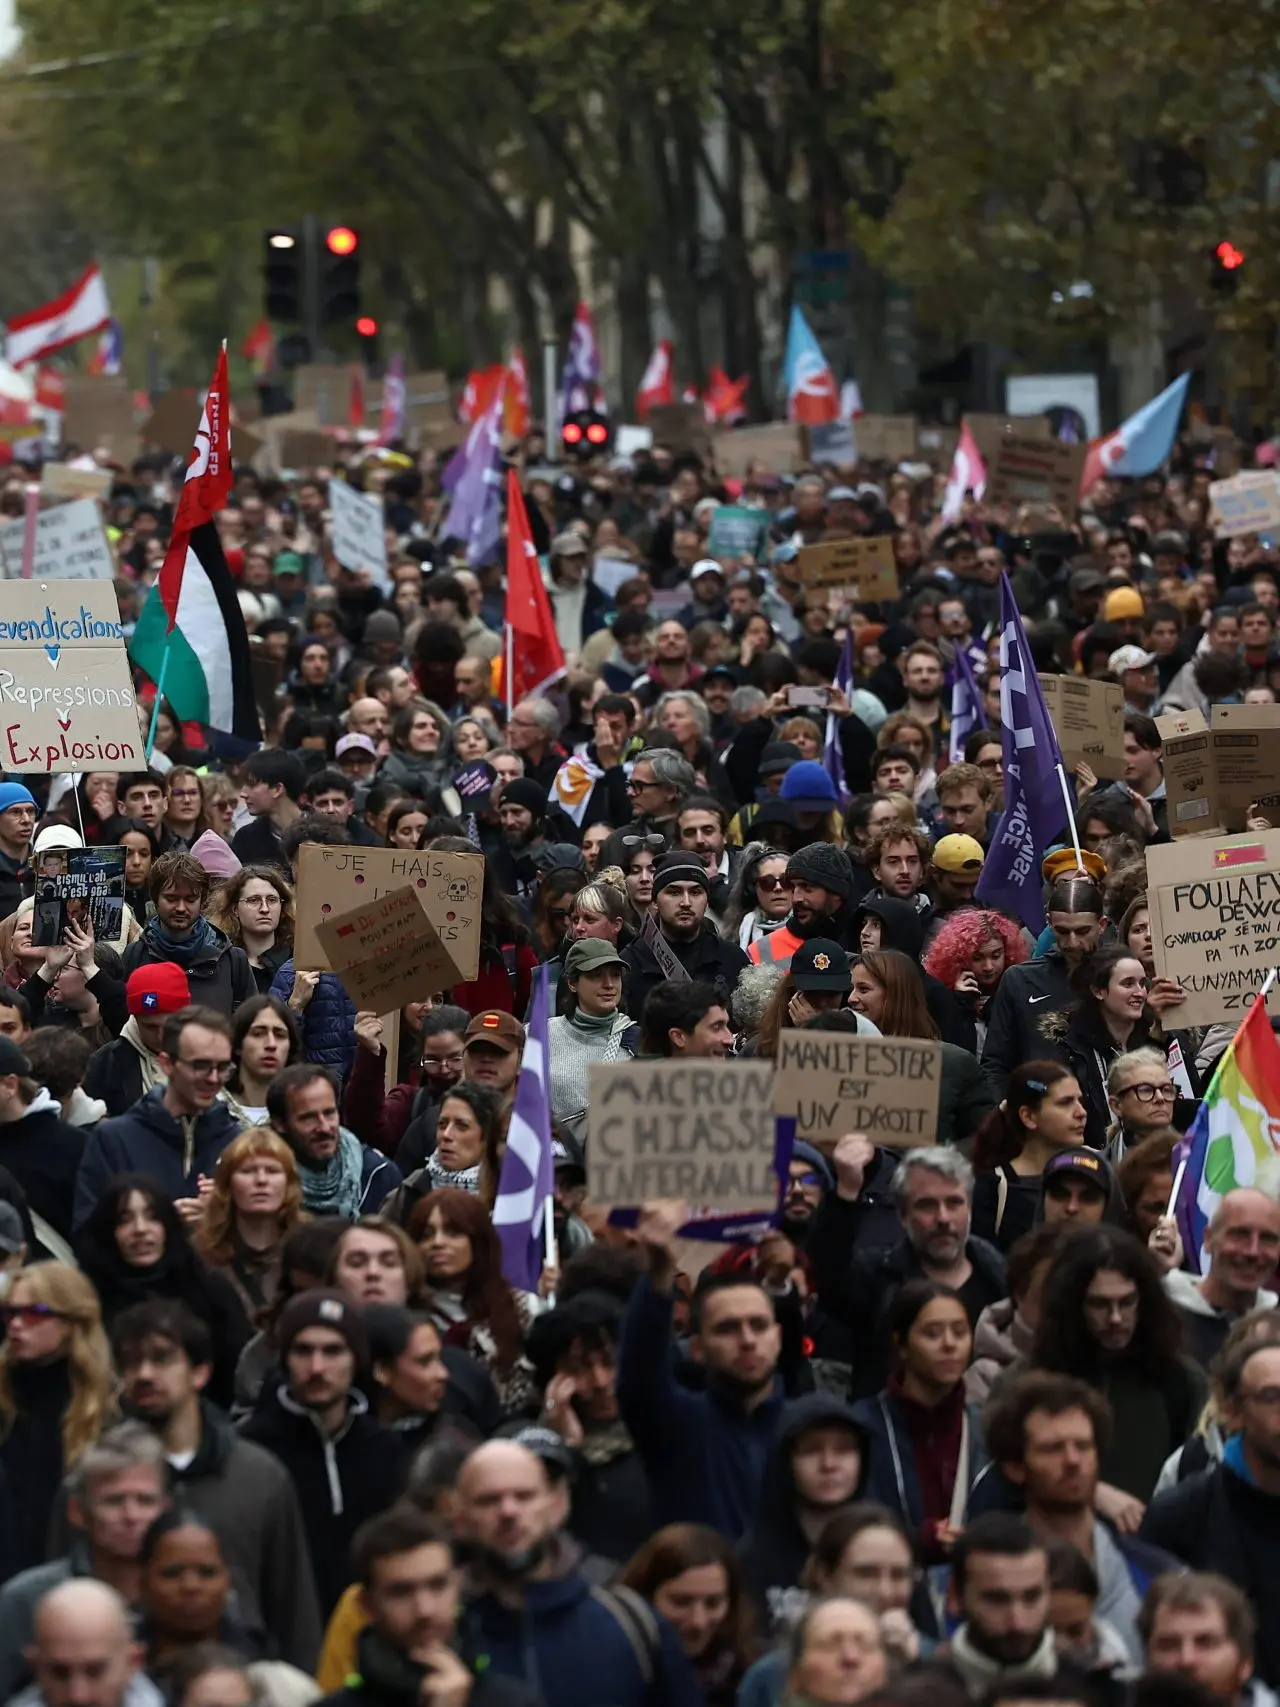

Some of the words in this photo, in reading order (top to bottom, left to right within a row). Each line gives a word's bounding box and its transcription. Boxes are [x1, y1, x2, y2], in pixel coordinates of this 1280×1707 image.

[6, 724, 135, 772] Explosion
[1205, 949, 1222, 963] PA
[1229, 944, 1249, 958] TA
[781, 1039, 935, 1081] MANIFESTER
[601, 1071, 770, 1105] MACRON
[838, 1080, 874, 1100] EST
[598, 1108, 774, 1157] CHIASSE
[797, 1101, 839, 1131] UN
[855, 1105, 928, 1134] DROIT
